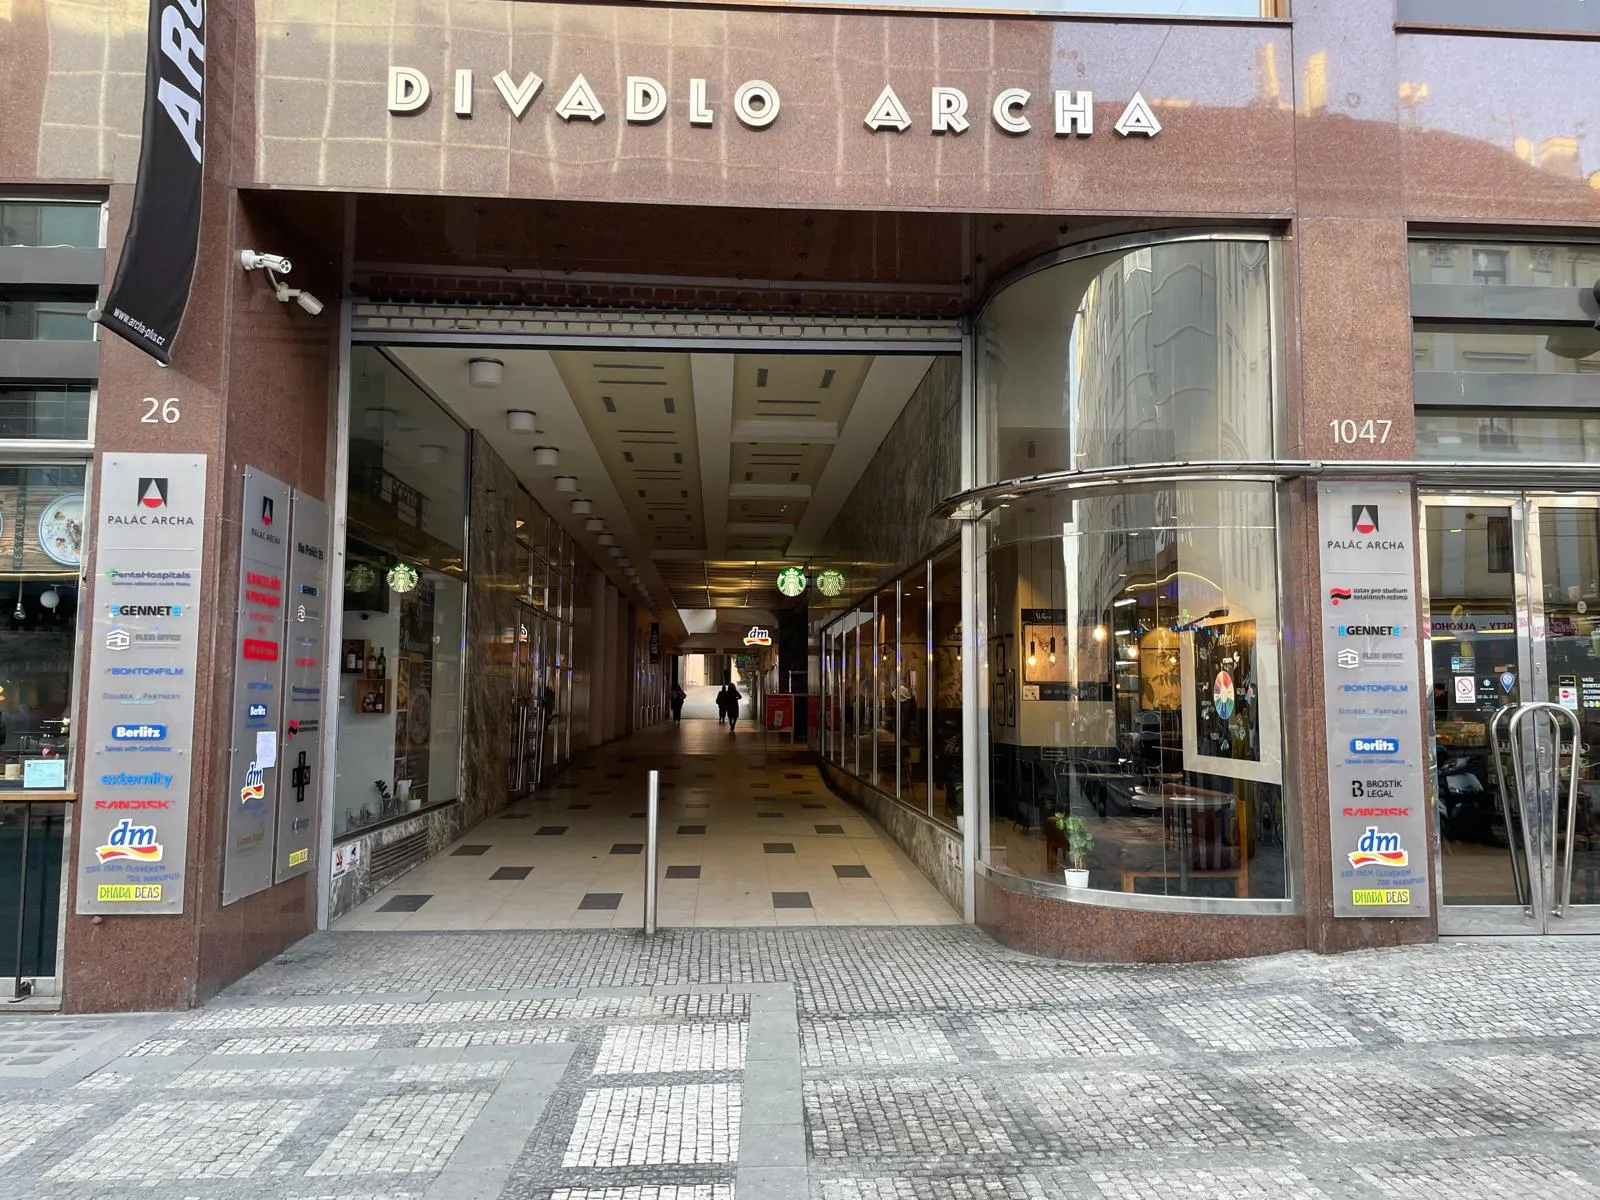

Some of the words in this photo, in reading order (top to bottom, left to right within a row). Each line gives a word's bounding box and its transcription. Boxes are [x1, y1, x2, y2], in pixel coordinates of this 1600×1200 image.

[387, 65, 782, 130] DIVADLO
[863, 83, 1163, 138] ARCHA
[113, 307, 166, 346] www.archa-plus.cz
[140, 397, 181, 424] 26
[1329, 419, 1393, 444] 1047
[151, 515, 194, 526] ARCHA
[1366, 541, 1405, 550] ARCHA
[120, 605, 172, 616] GENNET
[1347, 625, 1393, 636] GENNET
[111, 667, 184, 675] BONTONFILM
[1344, 684, 1408, 693] BONTONFILM
[116, 726, 161, 738] Berlitz
[1354, 739, 1395, 751] Berlitz
[101, 772, 174, 790] externity
[1366, 778, 1403, 788] BROSTÍK
[1367, 790, 1395, 798] LEGAL
[110, 820, 155, 846] dm
[1360, 828, 1399, 852] dm
[99, 886, 132, 899] DHABA
[134, 886, 161, 899] BEAS
[1354, 891, 1383, 902] DHABA
[1386, 891, 1409, 902] BEAS
